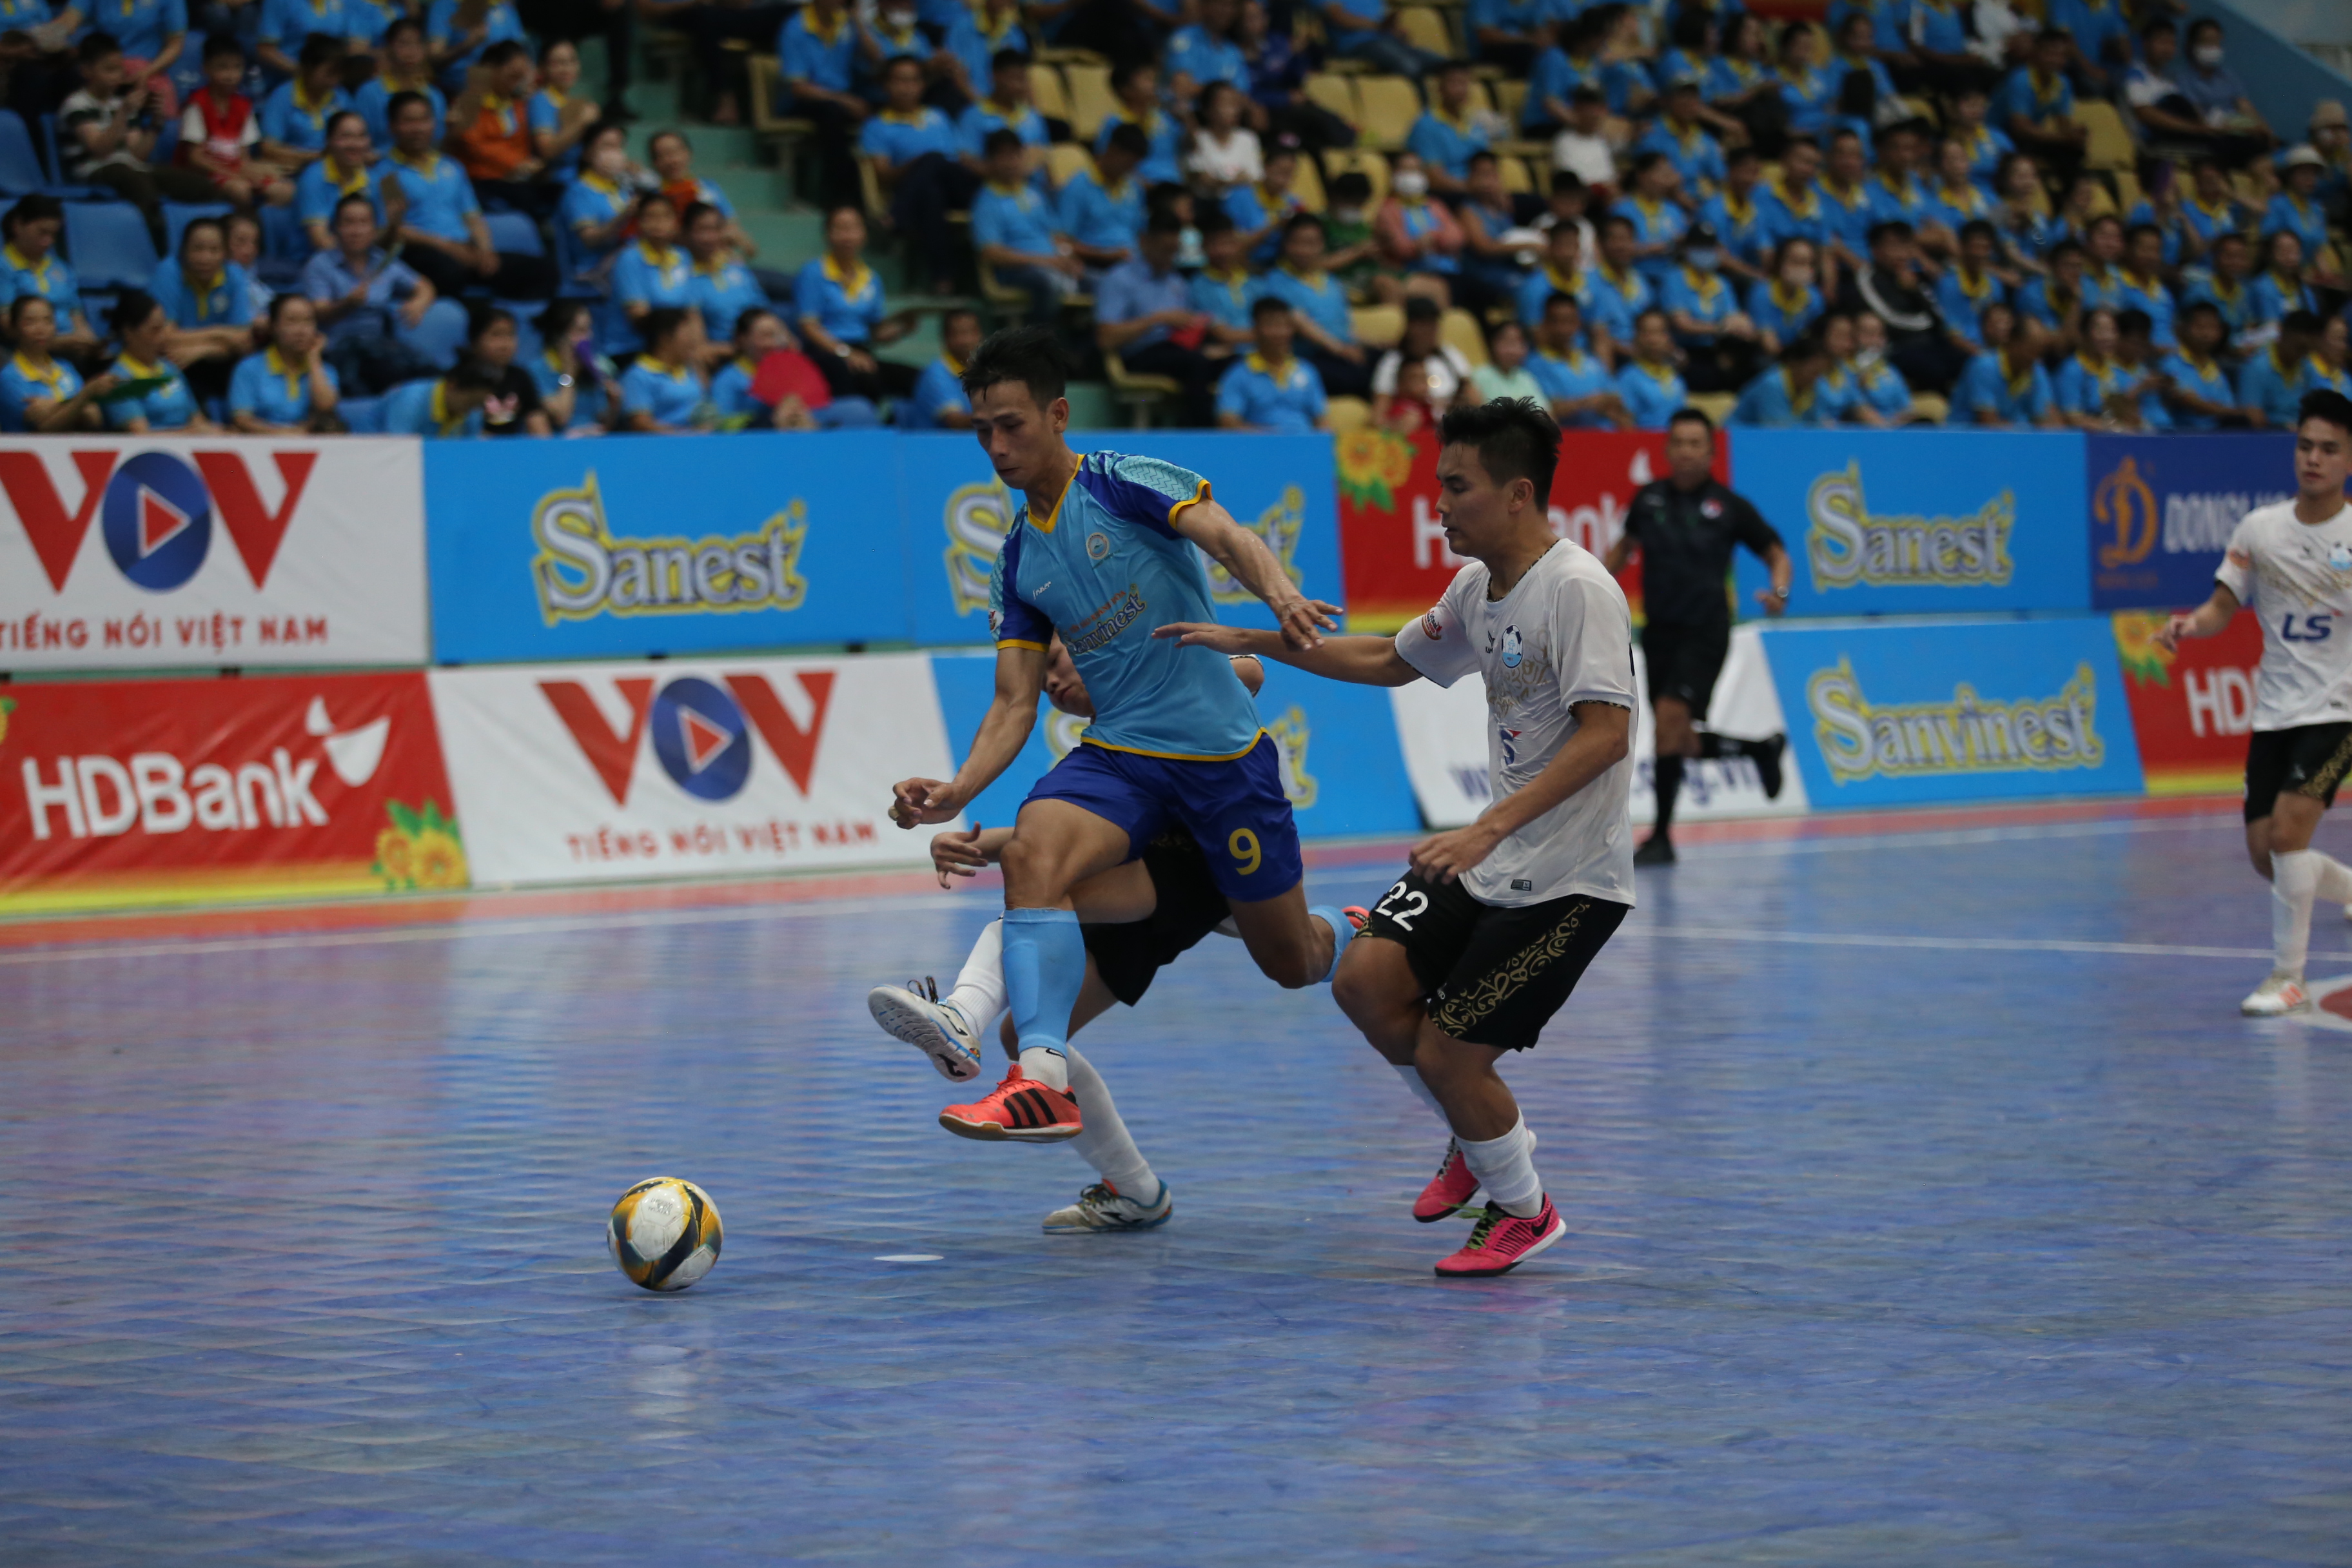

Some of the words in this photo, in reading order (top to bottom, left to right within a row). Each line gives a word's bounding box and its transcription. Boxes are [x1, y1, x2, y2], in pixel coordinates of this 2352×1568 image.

[532, 469, 808, 627] Sanest
[1412, 494, 1641, 569] Hank
[1807, 459, 2015, 594] Sanest
[103, 611, 162, 647] NÓI
[175, 611, 245, 654] VIỆT
[259, 612, 328, 645] NAM
[2281, 612, 2332, 643] LS
[1808, 652, 2104, 787] Sanvinest
[2184, 667, 2260, 737] HD
[22, 746, 329, 839] HDBank
[1228, 827, 1262, 876] 9
[1375, 881, 1429, 932] 22
